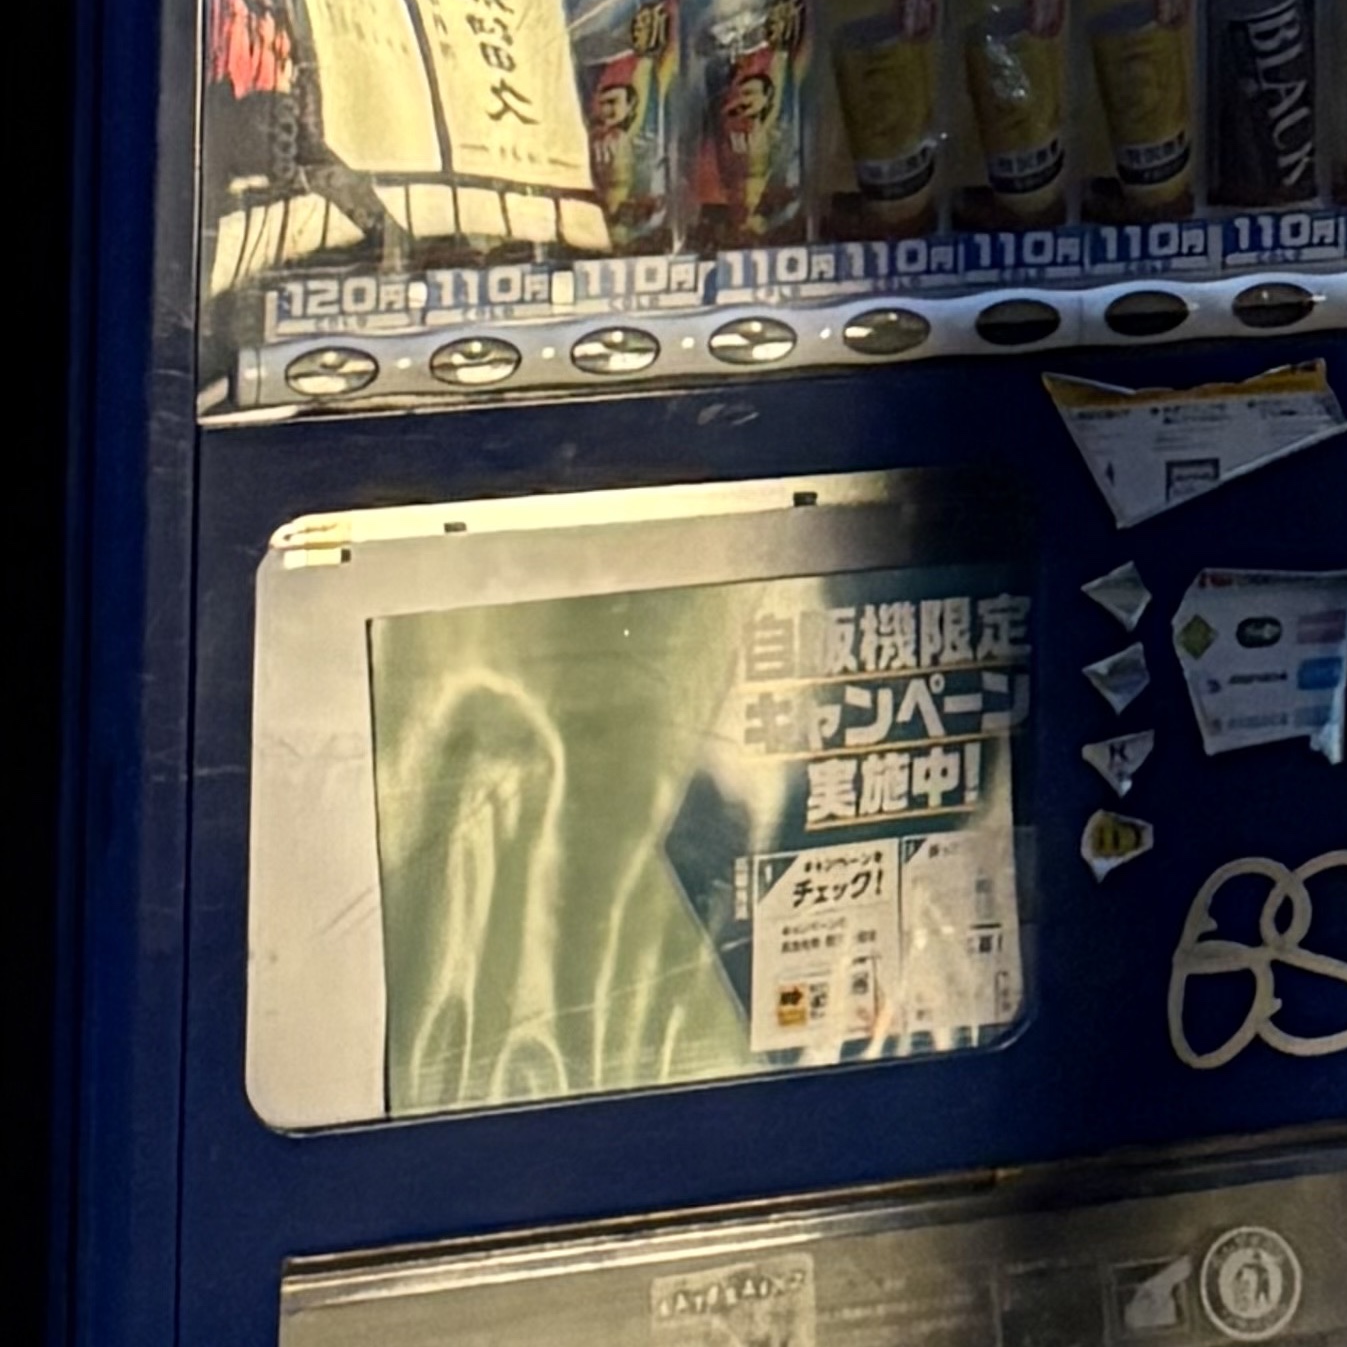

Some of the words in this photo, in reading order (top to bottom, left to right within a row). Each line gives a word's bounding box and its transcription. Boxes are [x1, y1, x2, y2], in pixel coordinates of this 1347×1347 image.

[630, 1, 668, 53] 新
[974, 229, 1082, 267] 110円
[1101, 225, 1206, 257] 110円
[1233, 215, 1339, 247] 110円
[584, 256, 700, 297] 110円
[724, 247, 836, 287] 110円
[847, 238, 954, 279] 110円
[286, 278, 407, 317] 120円
[429, 265, 550, 306] 110円
[742, 594, 1032, 684] 自販機限定
[744, 671, 1031, 753] キャンペーン
[806, 742, 982, 820] 実施中!
[793, 869, 883, 909] チェック!
